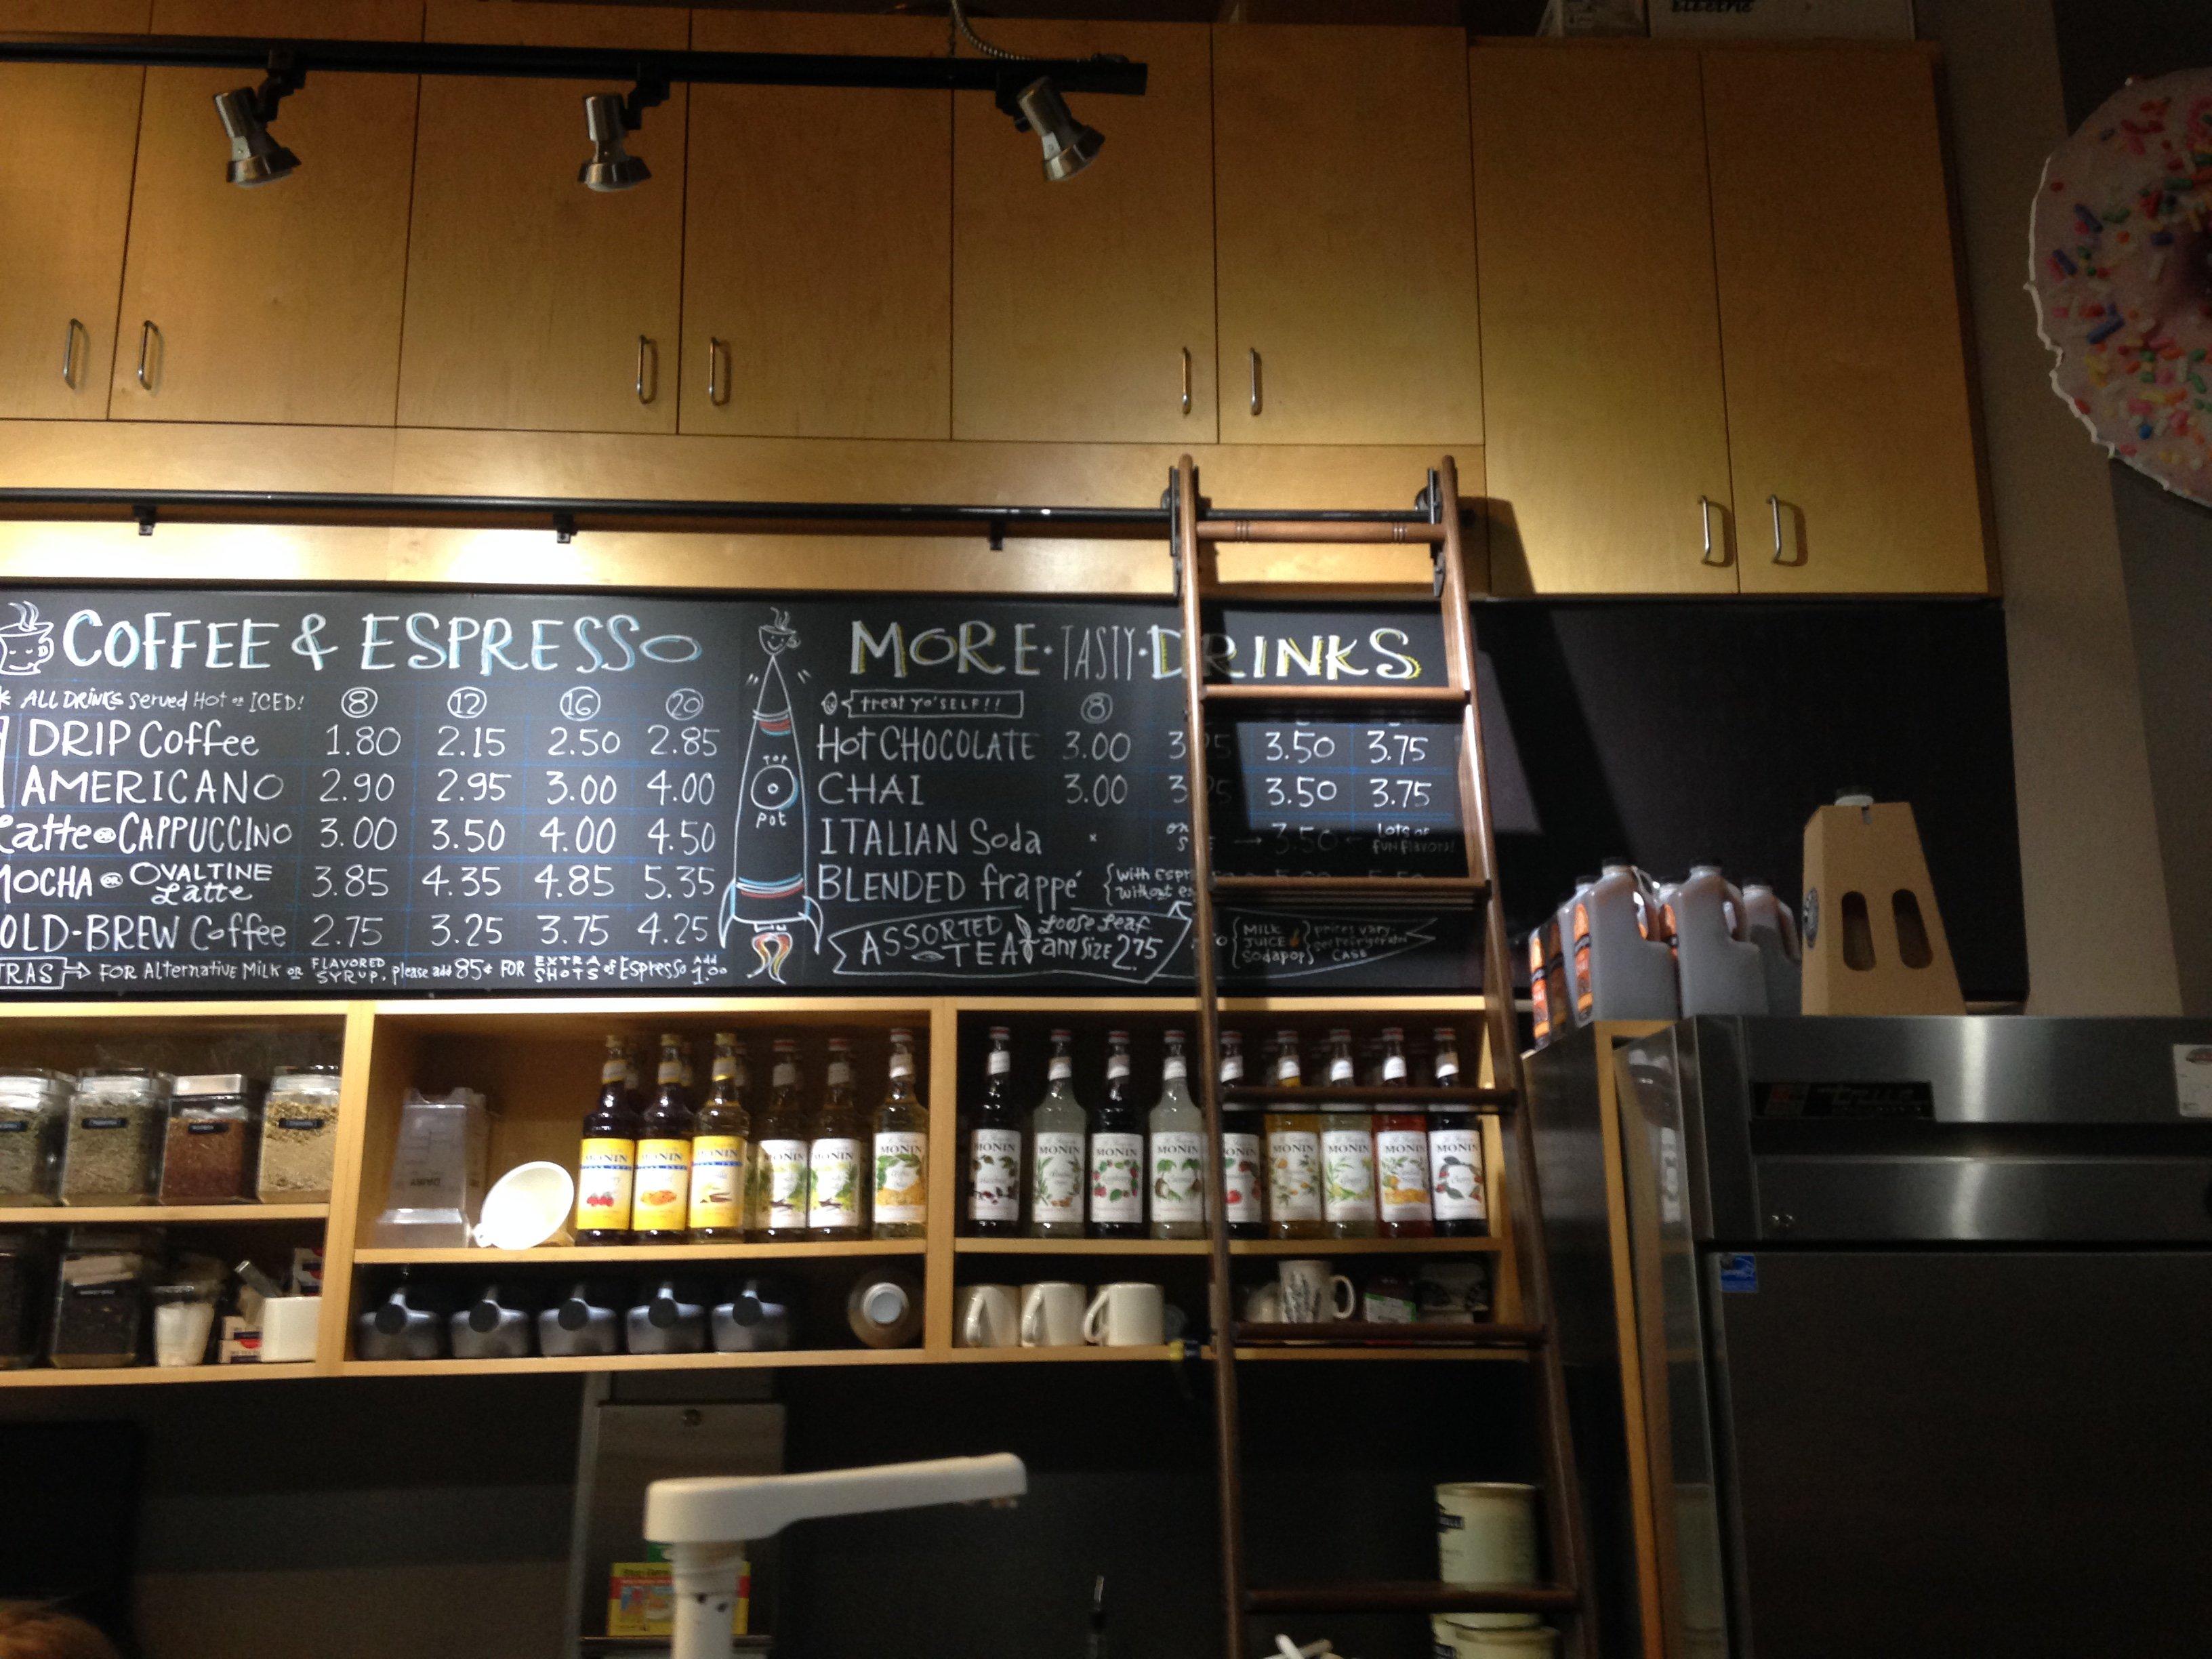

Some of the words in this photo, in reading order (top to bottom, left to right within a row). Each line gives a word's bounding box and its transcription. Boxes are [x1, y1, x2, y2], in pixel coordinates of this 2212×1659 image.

[63, 609, 279, 670] COFFEE
[291, 613, 338, 671] &
[361, 613, 702, 676] ESPRESSO
[850, 620, 1040, 678] MORE
[1061, 626, 1136, 682] TASTY
[1151, 625, 1421, 680] DRINKS
[20, 689, 58, 710] ALL
[249, 692, 304, 712] ICED!
[29, 719, 131, 757] DRIP
[140, 719, 259, 758] Coffee
[327, 725, 401, 756] 1.80
[438, 726, 506, 758] 2.15
[548, 726, 620, 756] 2.50
[648, 724, 719, 756] 2.85
[817, 723, 876, 763] Hot
[880, 726, 1040, 761] CHOCOLATE
[1062, 731, 1131, 762] 3.00
[1265, 731, 1336, 764] 3.50
[1367, 730, 1429, 765] 3.75
[22, 764, 283, 805] AMERICANO
[320, 768, 395, 803] 2.90
[437, 769, 512, 803] 2.95
[546, 771, 617, 805] 3.00
[647, 770, 715, 806] 4.00
[818, 773, 924, 806] CHAI
[1063, 774, 1128, 807] 3.00
[1266, 777, 1337, 808] 3.50
[1370, 778, 1432, 808] 3.75
[119, 812, 291, 854] CAPPUCCINO
[319, 816, 398, 851] 3.00
[431, 819, 506, 853] 3.50
[540, 816, 616, 854] 4.00
[648, 817, 716, 855] 4.50
[821, 818, 958, 855] ITALIAN
[969, 818, 1042, 855] Soda
[129, 862, 272, 885] OVALTINE
[312, 865, 390, 898] 3.85
[422, 865, 501, 897] 4.35
[535, 864, 615, 899] 4.85
[644, 865, 715, 899] 5.35
[818, 863, 966, 903] BLENDED
[190, 912, 286, 950] Coffee
[311, 913, 384, 948] 2.75
[430, 913, 504, 947] 3.25
[537, 914, 609, 946] 3.75
[637, 912, 708, 945] 4.25
[861, 914, 1002, 966] ASSORTED
[942, 937, 1018, 968] TEA
[99, 963, 138, 982] FOR
[311, 957, 386, 970] FLAVORED
[391, 961, 428, 985] please
[501, 960, 525, 979] FOR
[533, 954, 600, 968] EXTRA
[535, 967, 600, 985] SHOTS
[881, 1143, 922, 1155] MONIN
[1040, 1144, 1080, 1155] MONIN
[1096, 1147, 1138, 1158] MONIN
[1158, 1144, 1198, 1155] MONIN
[1273, 1144, 1313, 1154] MONIN
[1328, 1143, 1370, 1154] MONIN
[1385, 1144, 1425, 1154] MONIN
[1437, 1143, 1478, 1153] MONIN
